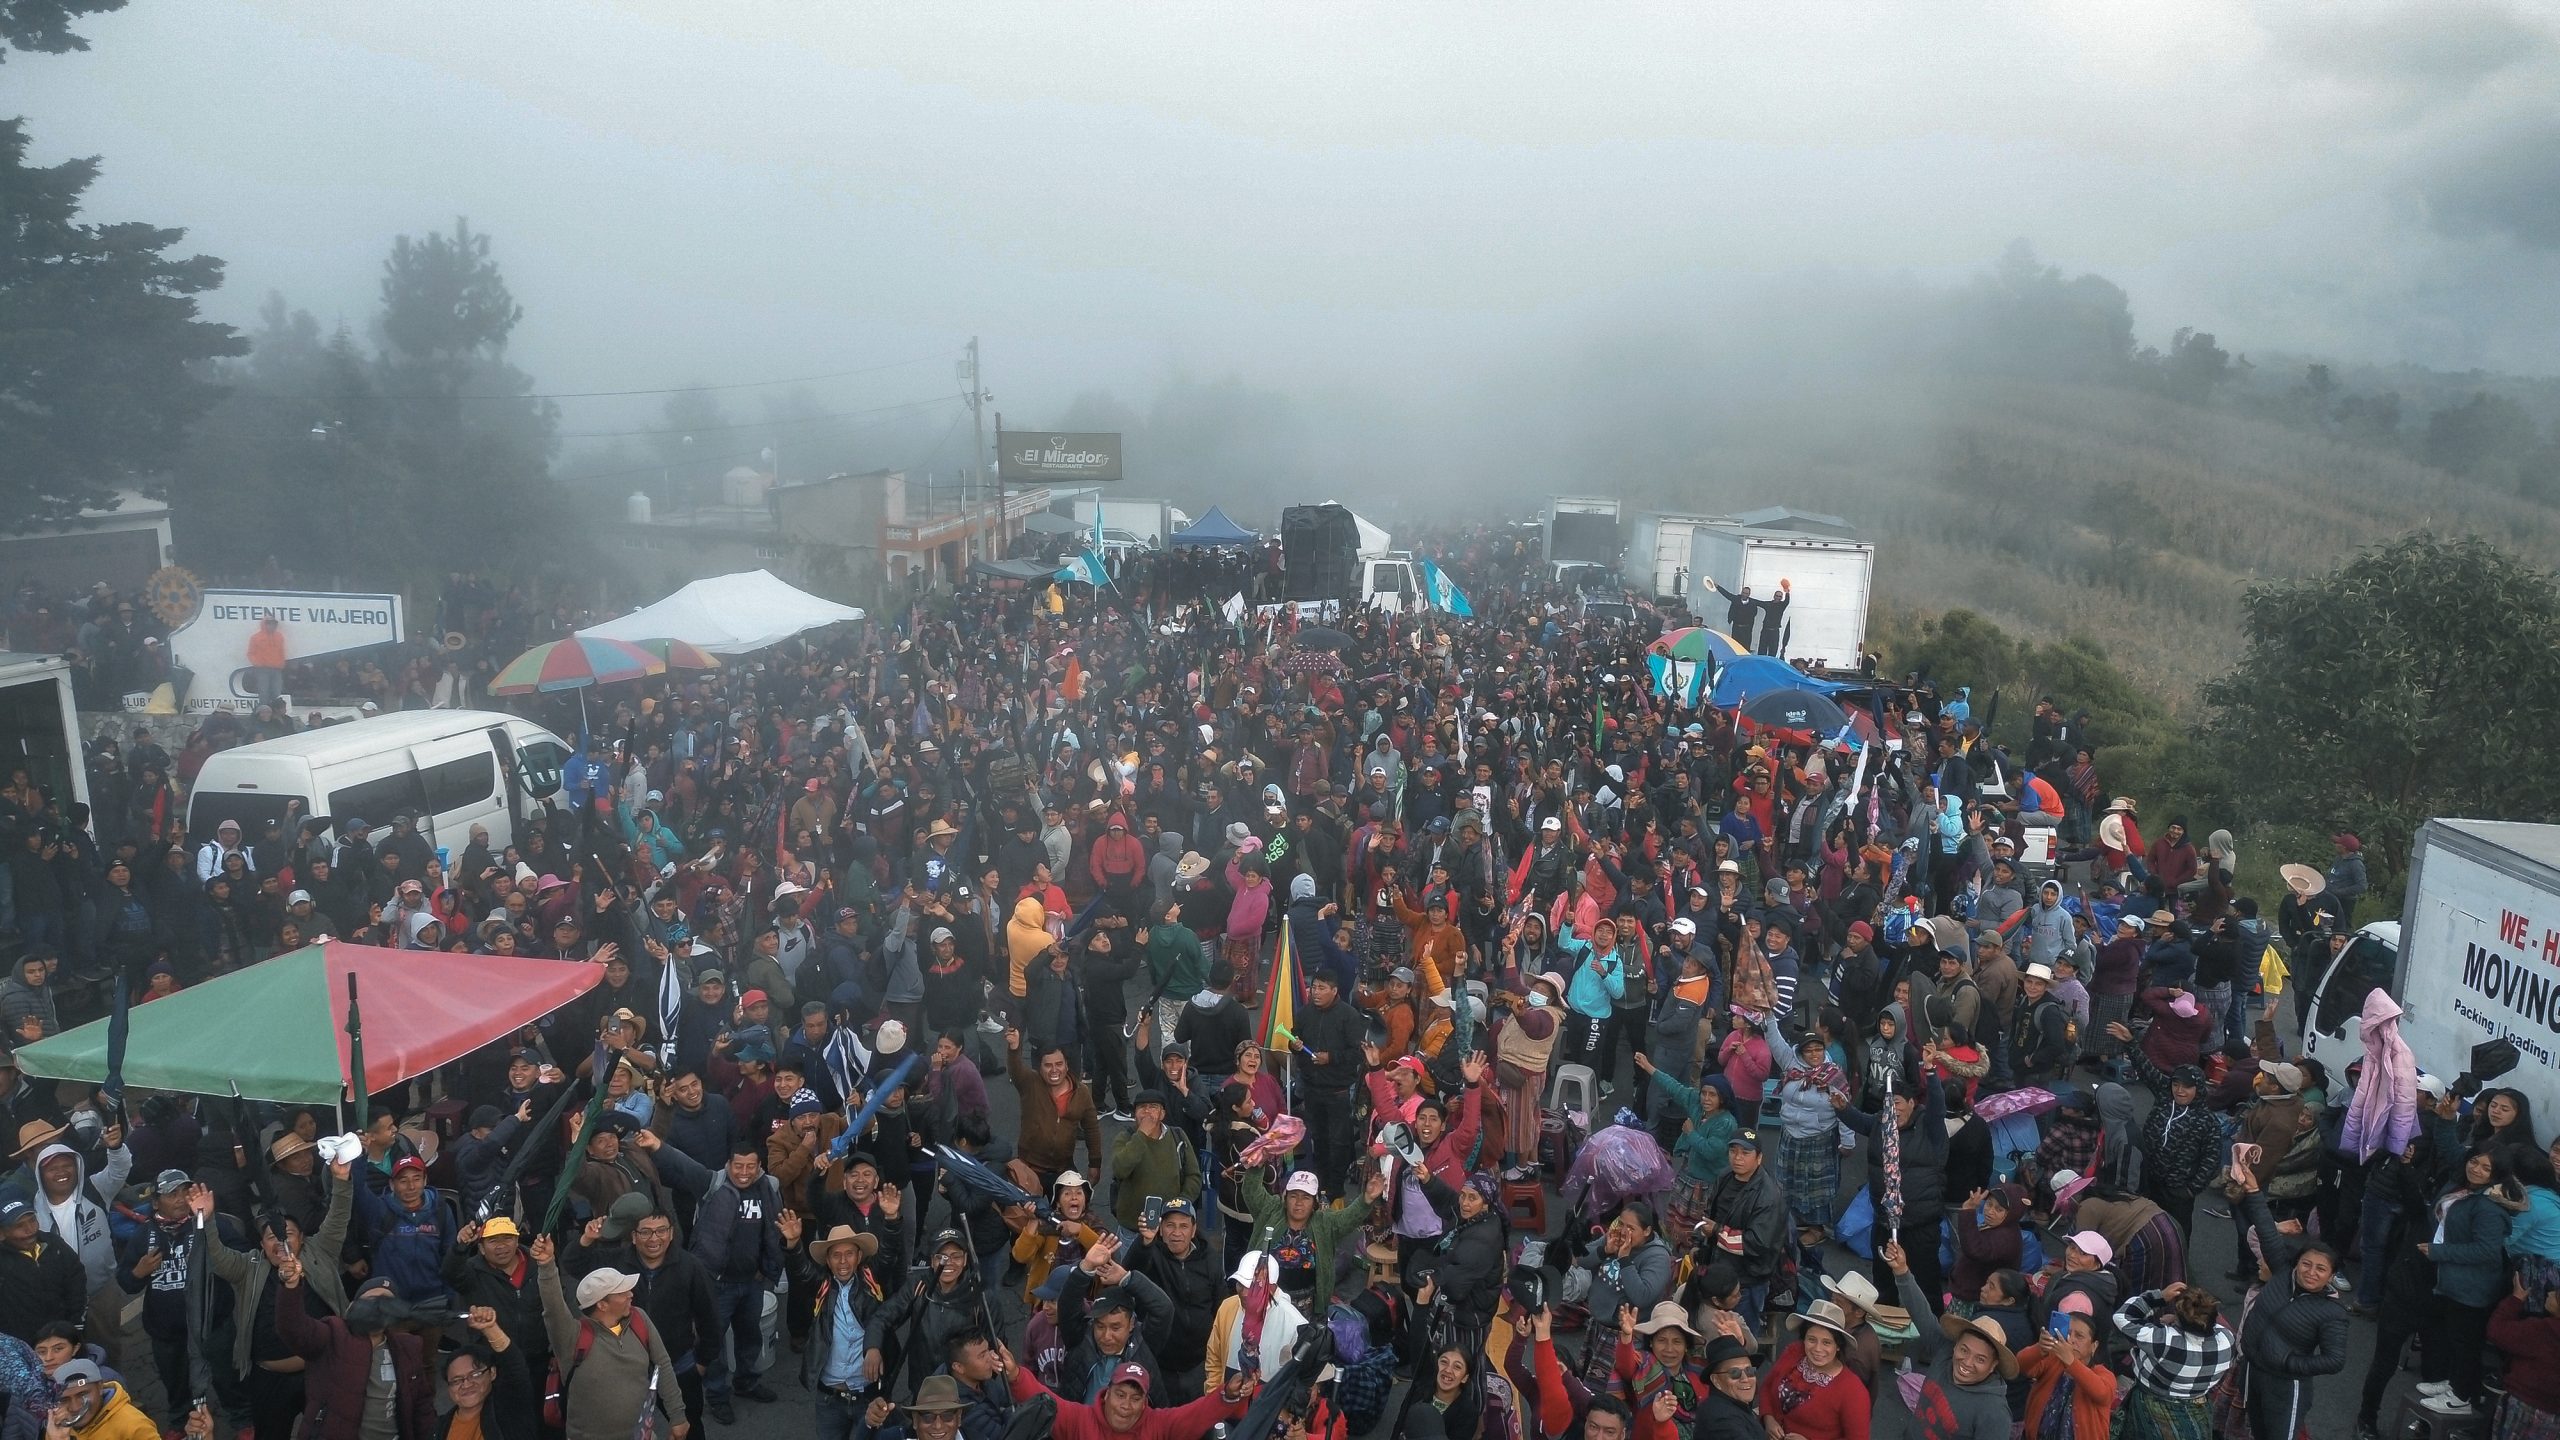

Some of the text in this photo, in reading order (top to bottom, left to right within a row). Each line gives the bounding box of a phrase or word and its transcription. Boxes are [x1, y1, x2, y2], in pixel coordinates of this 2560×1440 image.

[1024, 449, 1103, 464] El Mirador
[213, 605, 388, 625] DETENTE VIAJERO
[2500, 908, 2530, 952] WE
[2542, 928, 2560, 967] H
[2462, 941, 2560, 1034] MOVING
[2307, 1031, 2317, 1054] 3
[2454, 998, 2494, 1036] Packing
[2503, 1025, 2549, 1065] Loading
